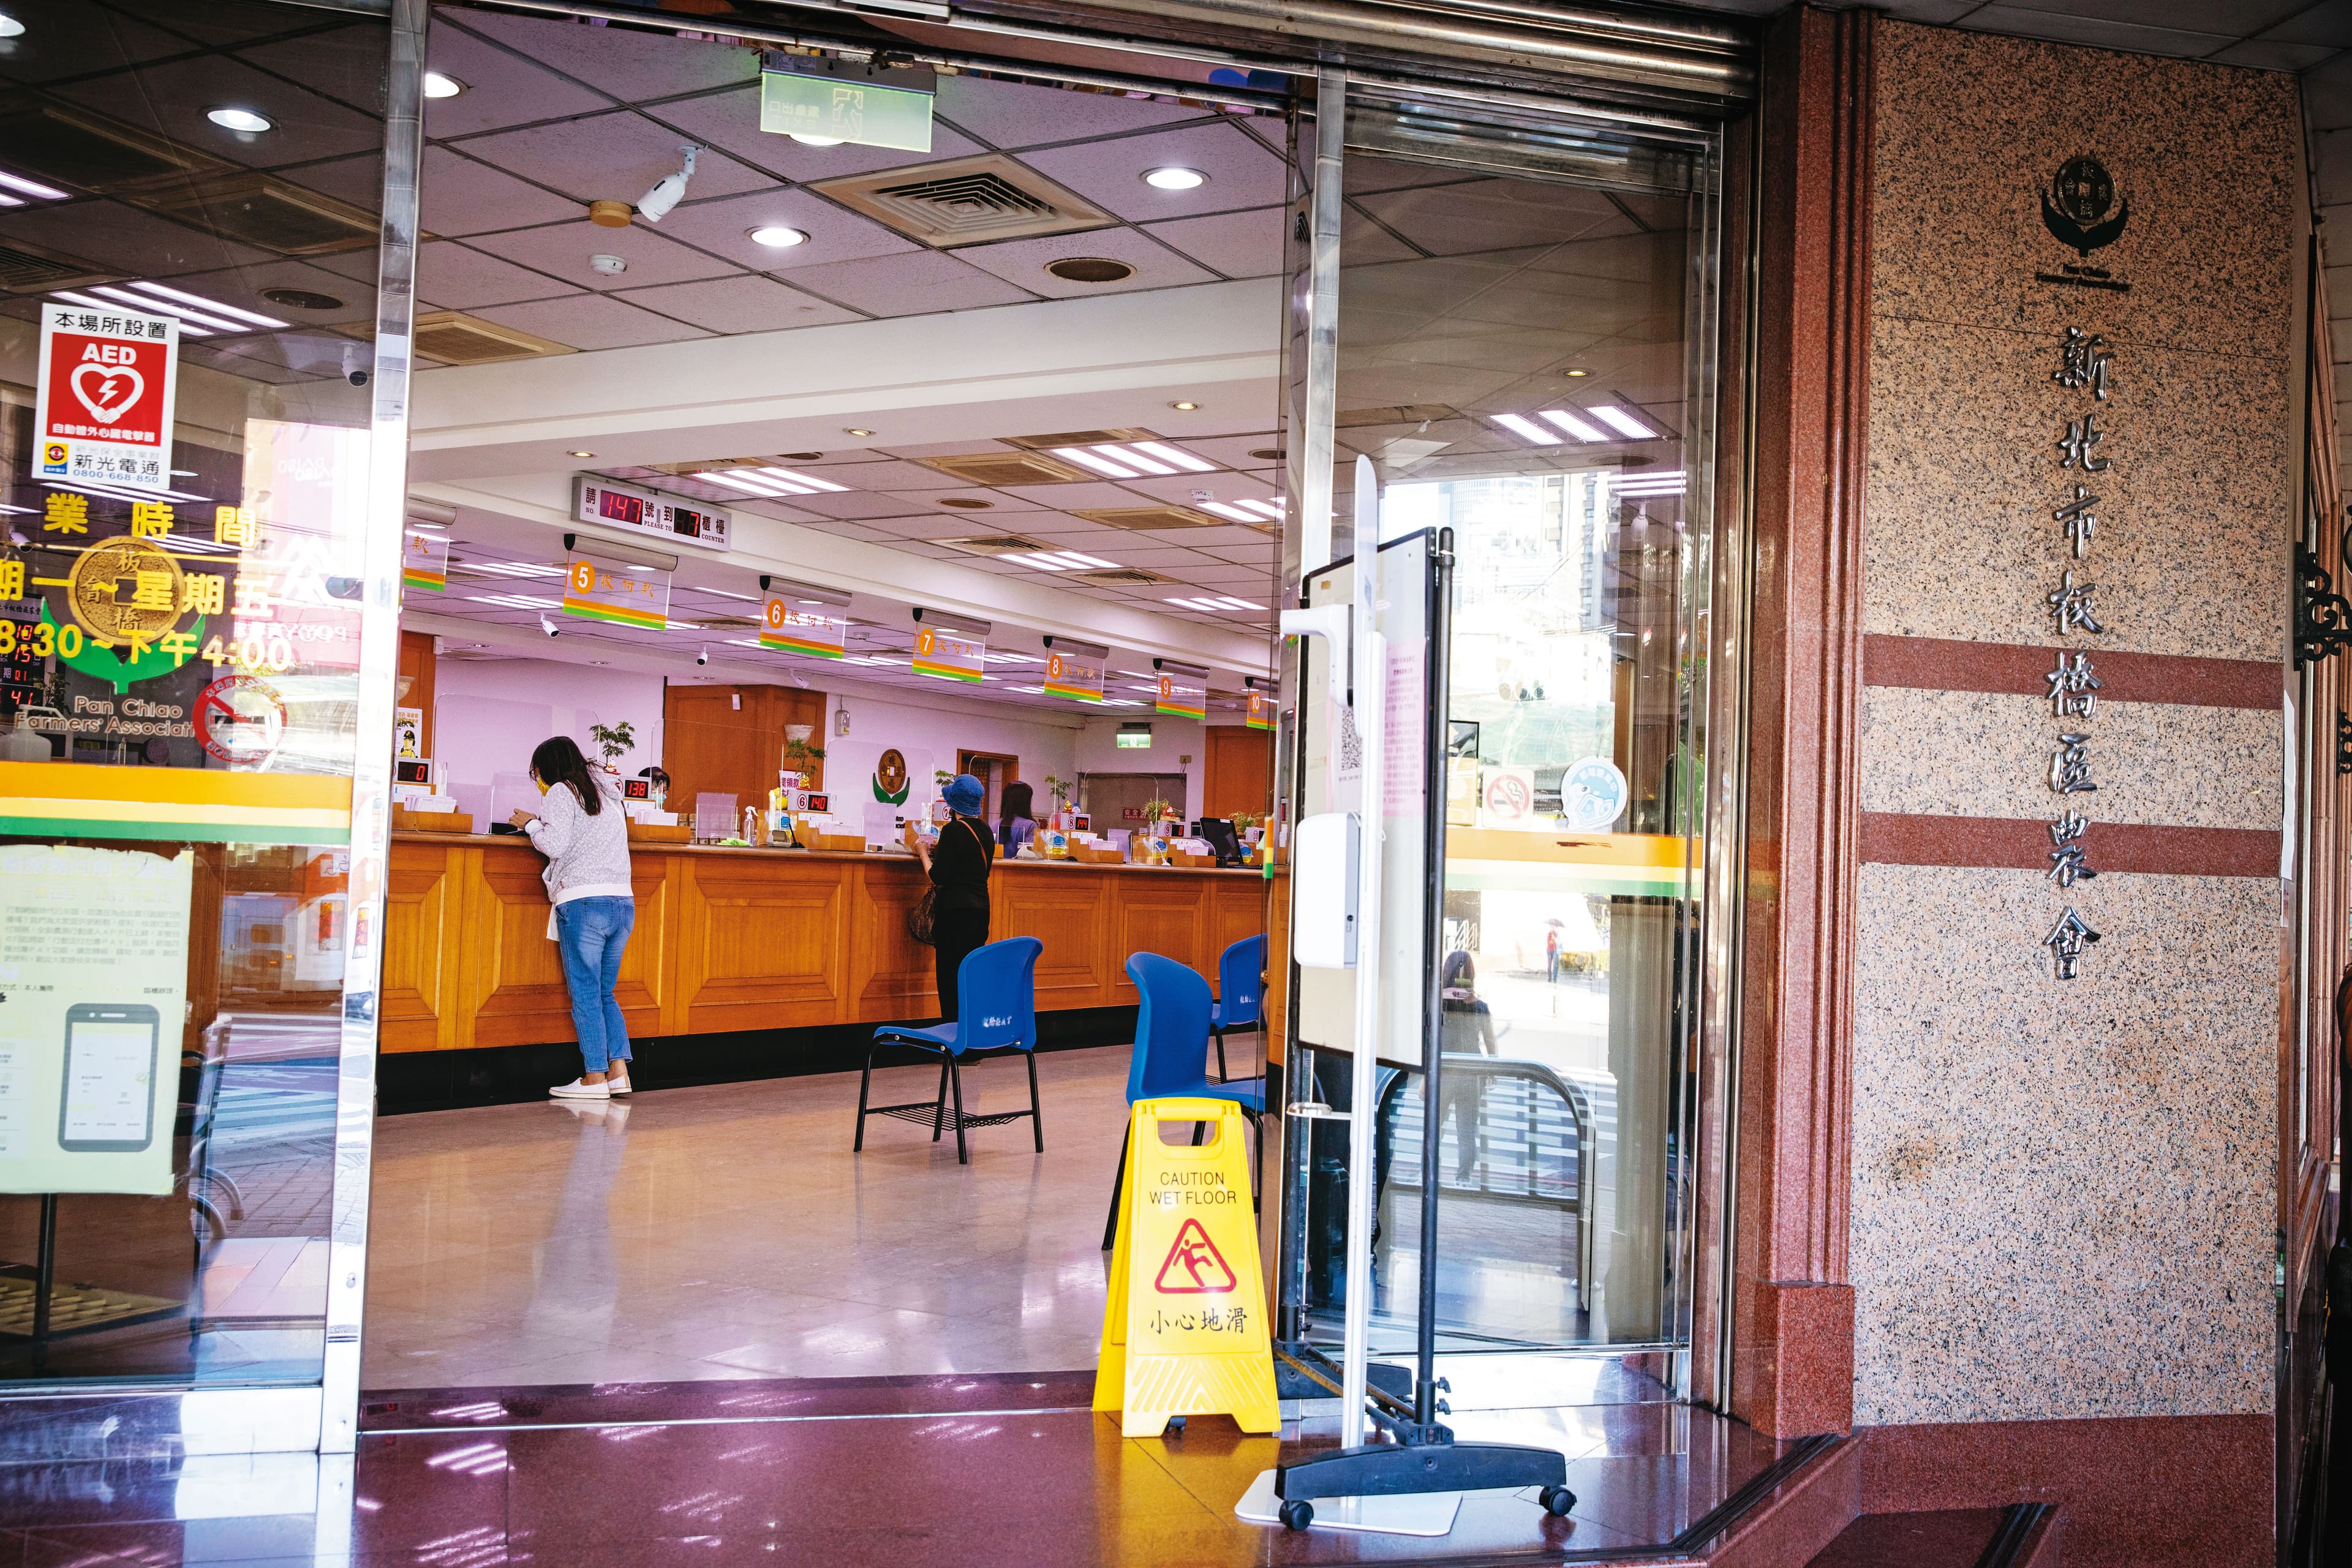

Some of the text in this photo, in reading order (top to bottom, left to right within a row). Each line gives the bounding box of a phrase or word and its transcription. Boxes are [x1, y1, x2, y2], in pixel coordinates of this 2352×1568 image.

[55, 312, 167, 340] 本場所設置
[81, 343, 137, 365] AED
[74, 454, 160, 475] 新光電通
[73, 469, 159, 484] 0800-668-850
[586, 487, 597, 505] 請
[607, 494, 643, 524] 147
[644, 502, 655, 519] 號
[663, 505, 673, 522] 到
[689, 512, 699, 536] 7
[586, 507, 595, 515] NO.
[644, 520, 664, 530] PLEASE
[701, 533, 725, 544] COUNTER
[578, 566, 589, 588] 5
[772, 604, 781, 624] 6
[924, 634, 931, 652] 7
[2043, 325, 2115, 980] 新北市板橋區農會
[1052, 658, 1060, 674] 8
[1163, 680, 1169, 695] 9
[74, 695, 183, 719] Pan Chiao
[1251, 696, 1260, 710] 10
[107, 716, 216, 738] Associati
[628, 782, 647, 796] 138
[810, 797, 826, 810] 140
[1077, 819, 1088, 829] 144
[1160, 1172, 1224, 1186] CAUTION
[1150, 1191, 1237, 1205] WET FLOOR
[1150, 1306, 1248, 1335] 小心地滑
